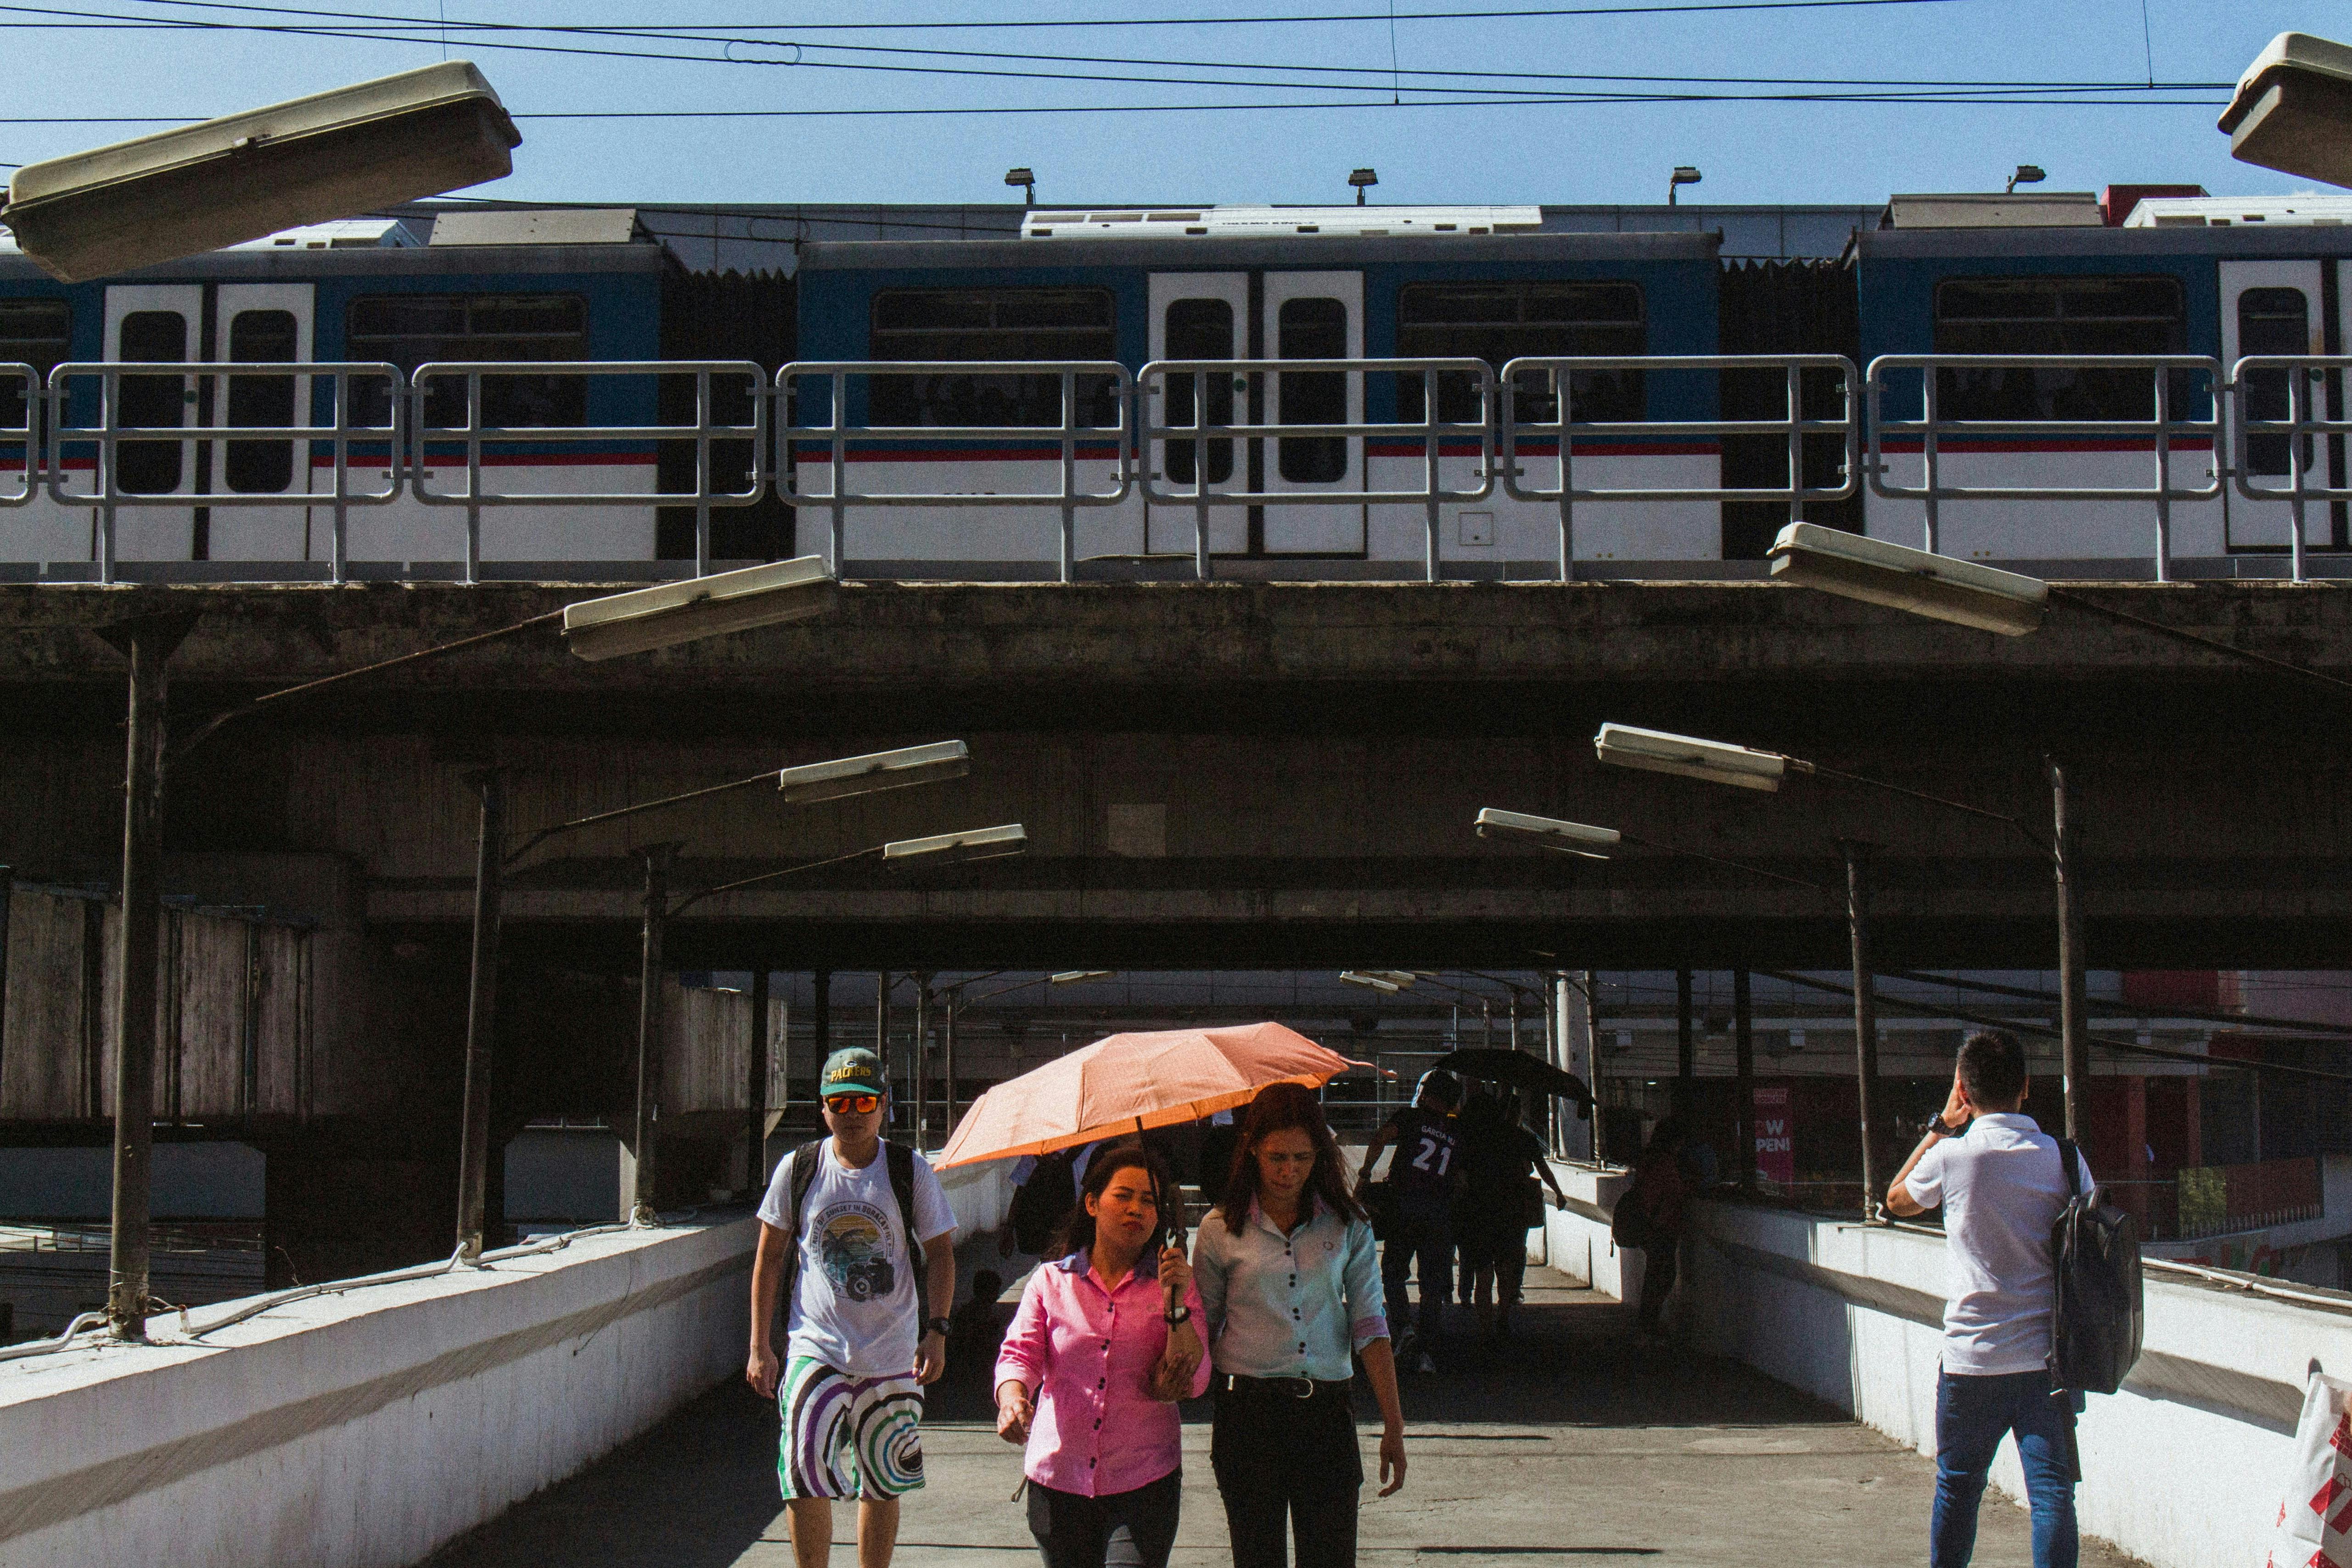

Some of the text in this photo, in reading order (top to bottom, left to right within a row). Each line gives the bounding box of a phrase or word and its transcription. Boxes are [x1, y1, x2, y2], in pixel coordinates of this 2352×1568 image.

[831, 1066, 871, 1082] PACKERS
[1421, 1125, 1446, 1140] GARCIA
[1756, 1137, 1791, 1152] PEN!
[1412, 1137, 1452, 1176] 21
[817, 1217, 825, 1225] OF
[825, 1205, 852, 1218] SUNSET
[862, 1205, 889, 1231] BORACAY
